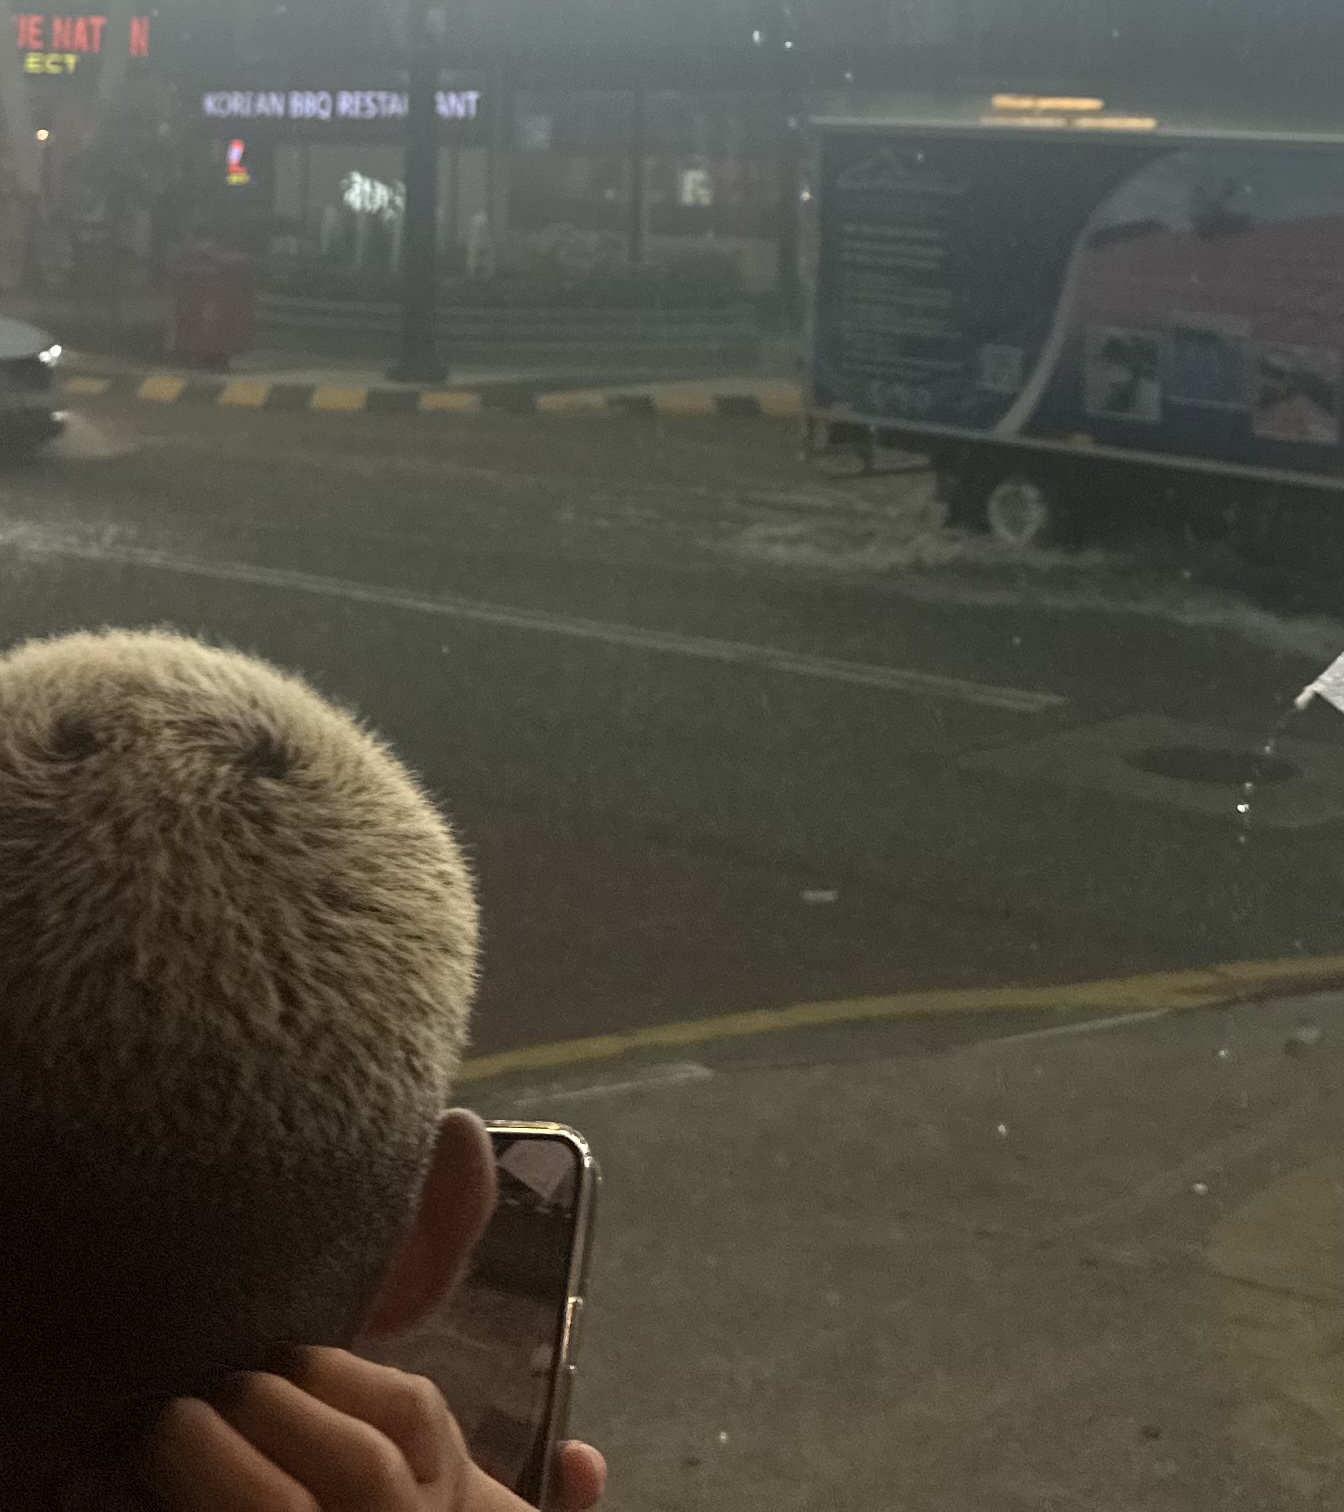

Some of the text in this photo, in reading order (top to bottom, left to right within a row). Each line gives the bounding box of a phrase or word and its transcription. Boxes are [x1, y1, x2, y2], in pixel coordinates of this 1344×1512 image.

[52, 15, 150, 57] NATN
[203, 90, 480, 120] KOREAN BBQ RESTAANT
